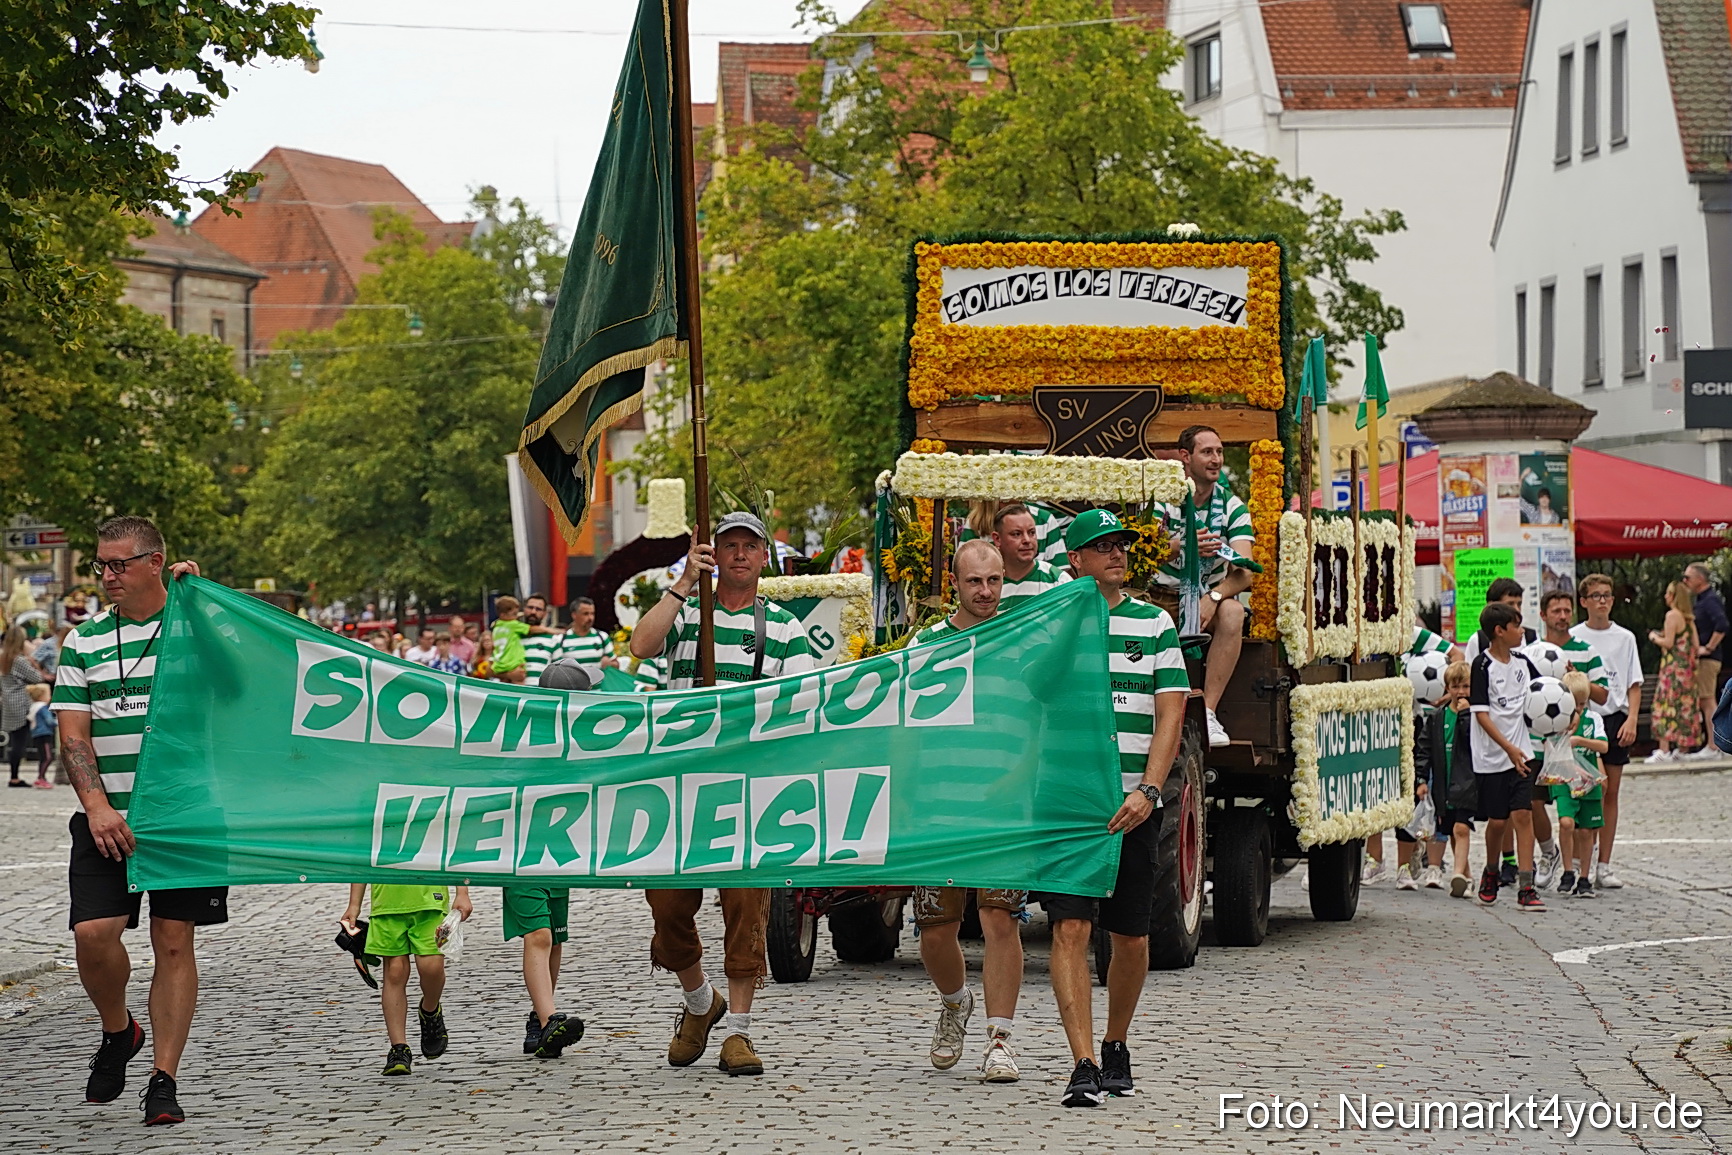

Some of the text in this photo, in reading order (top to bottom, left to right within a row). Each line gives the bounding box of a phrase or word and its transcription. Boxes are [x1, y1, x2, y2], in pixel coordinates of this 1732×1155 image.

[594, 234, 620, 265] 996
[946, 269, 1247, 324] SOMOS LOS VERDES!
[1691, 381, 1732, 396] SCH
[1058, 398, 1090, 420] SV
[1071, 417, 1137, 458] LING
[1623, 525, 1660, 539] Hotel
[1456, 579, 1492, 588] VOLKSF
[1468, 568, 1498, 578] JURA-
[300, 636, 973, 752] SOMOS LOS
[1113, 694, 1128, 705] rkt
[1315, 706, 1400, 759] OMOS LOS VERDES
[1328, 773, 1350, 819] SAN
[1352, 771, 1363, 812] DE
[375, 772, 888, 871] VERDES!
